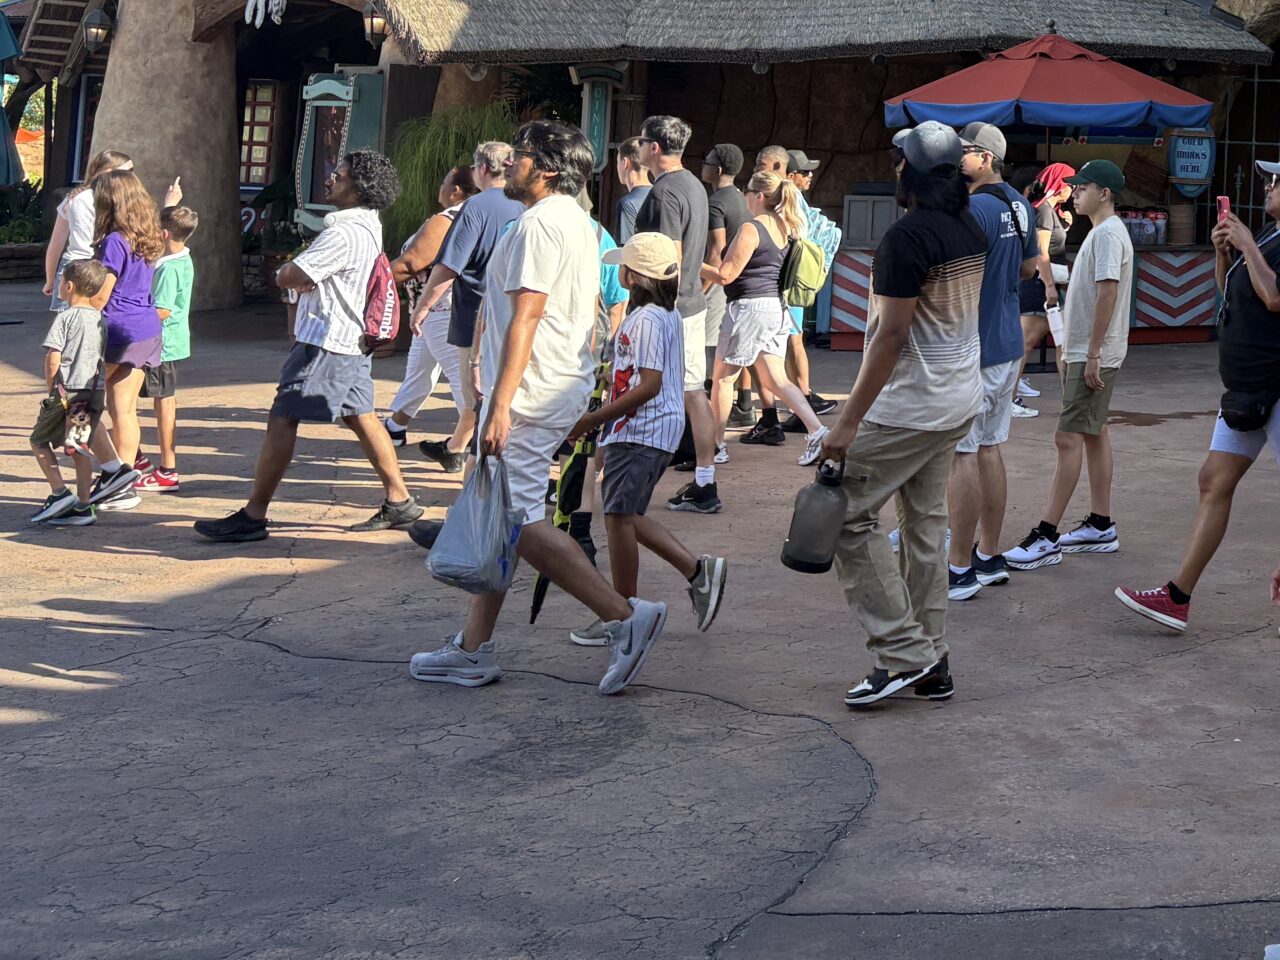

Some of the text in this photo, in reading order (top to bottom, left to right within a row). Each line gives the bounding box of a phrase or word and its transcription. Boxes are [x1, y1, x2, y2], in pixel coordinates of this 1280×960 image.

[591, 87, 602, 150] DININ
[1176, 150, 1207, 160] DRINKS
[1180, 164, 1201, 174] HERE
